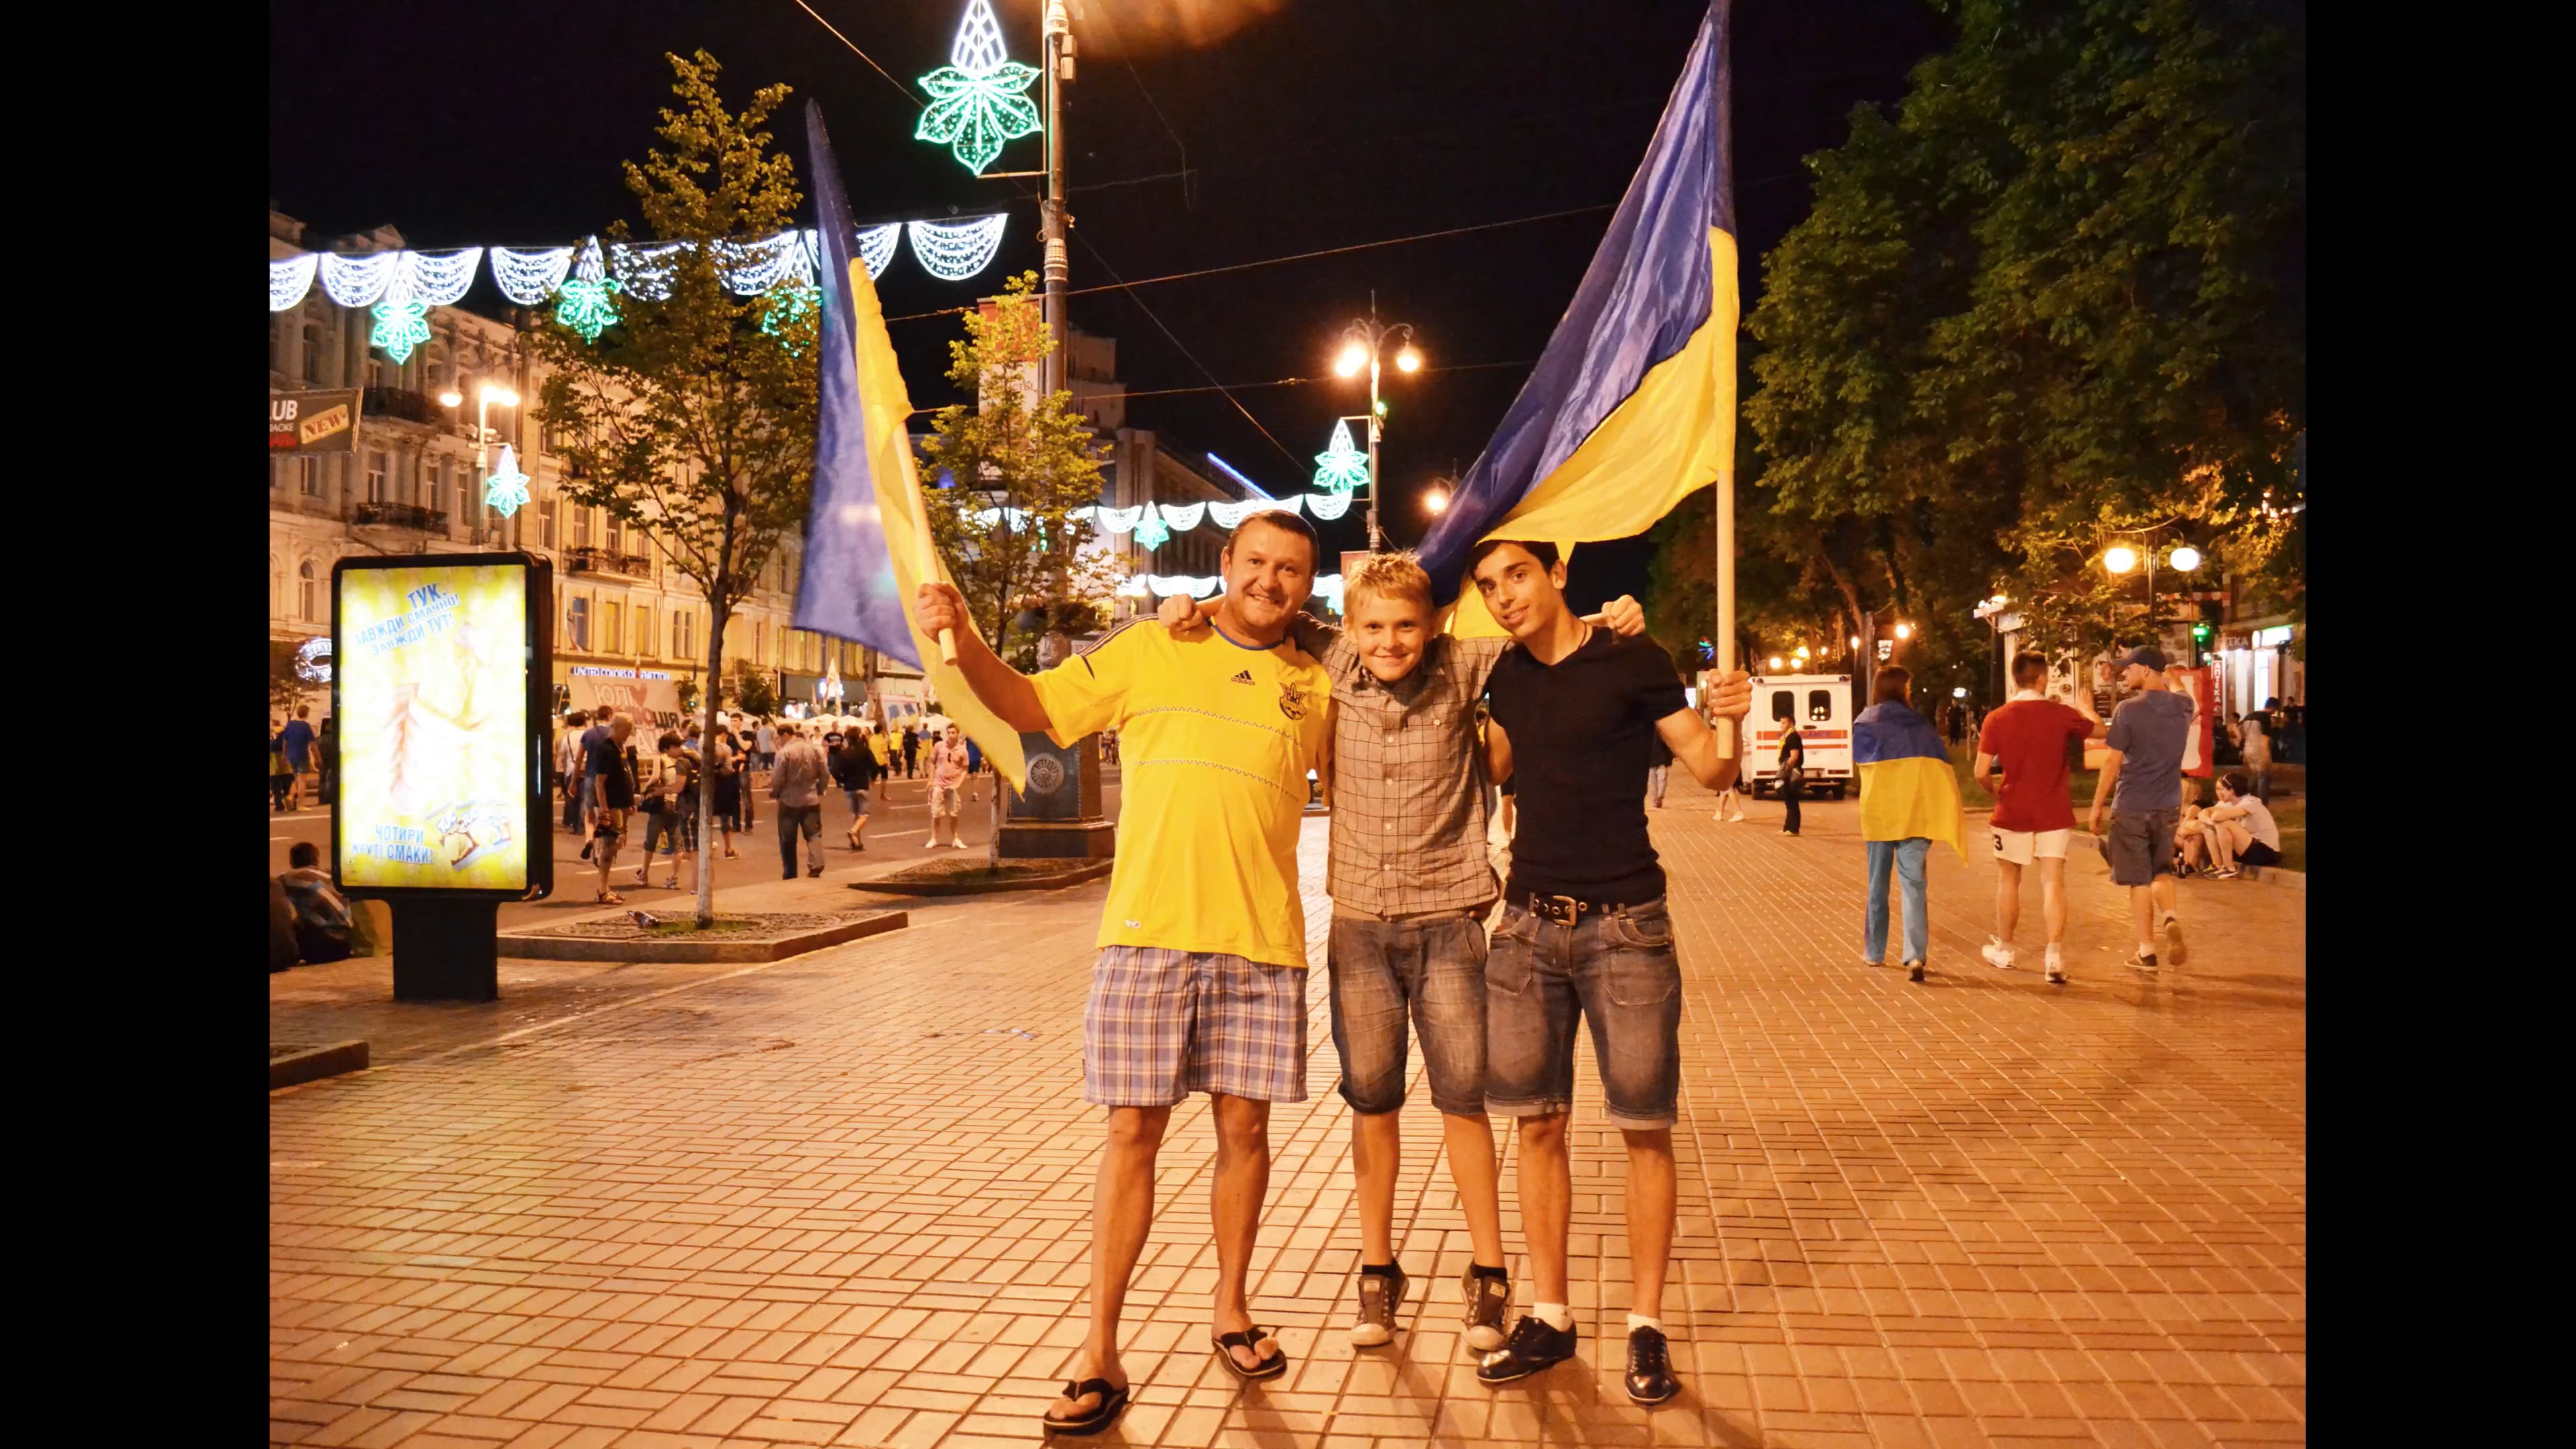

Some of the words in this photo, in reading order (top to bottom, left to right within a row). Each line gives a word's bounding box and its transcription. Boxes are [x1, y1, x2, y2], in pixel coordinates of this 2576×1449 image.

[270, 400, 298, 421] UB
[355, 616, 405, 645] ЗАВЖДИ
[407, 593, 460, 623] СМАЧНО!
[372, 625, 425, 655] ЗАВЖДИ
[427, 612, 455, 633] ТУТ!
[1231, 677, 1255, 686] adidas
[375, 824, 424, 842] ЧОТИРИ
[1994, 834, 2003, 851] 3
[353, 843, 383, 859] КРУТІ
[387, 845, 433, 863] СМАКИ!
